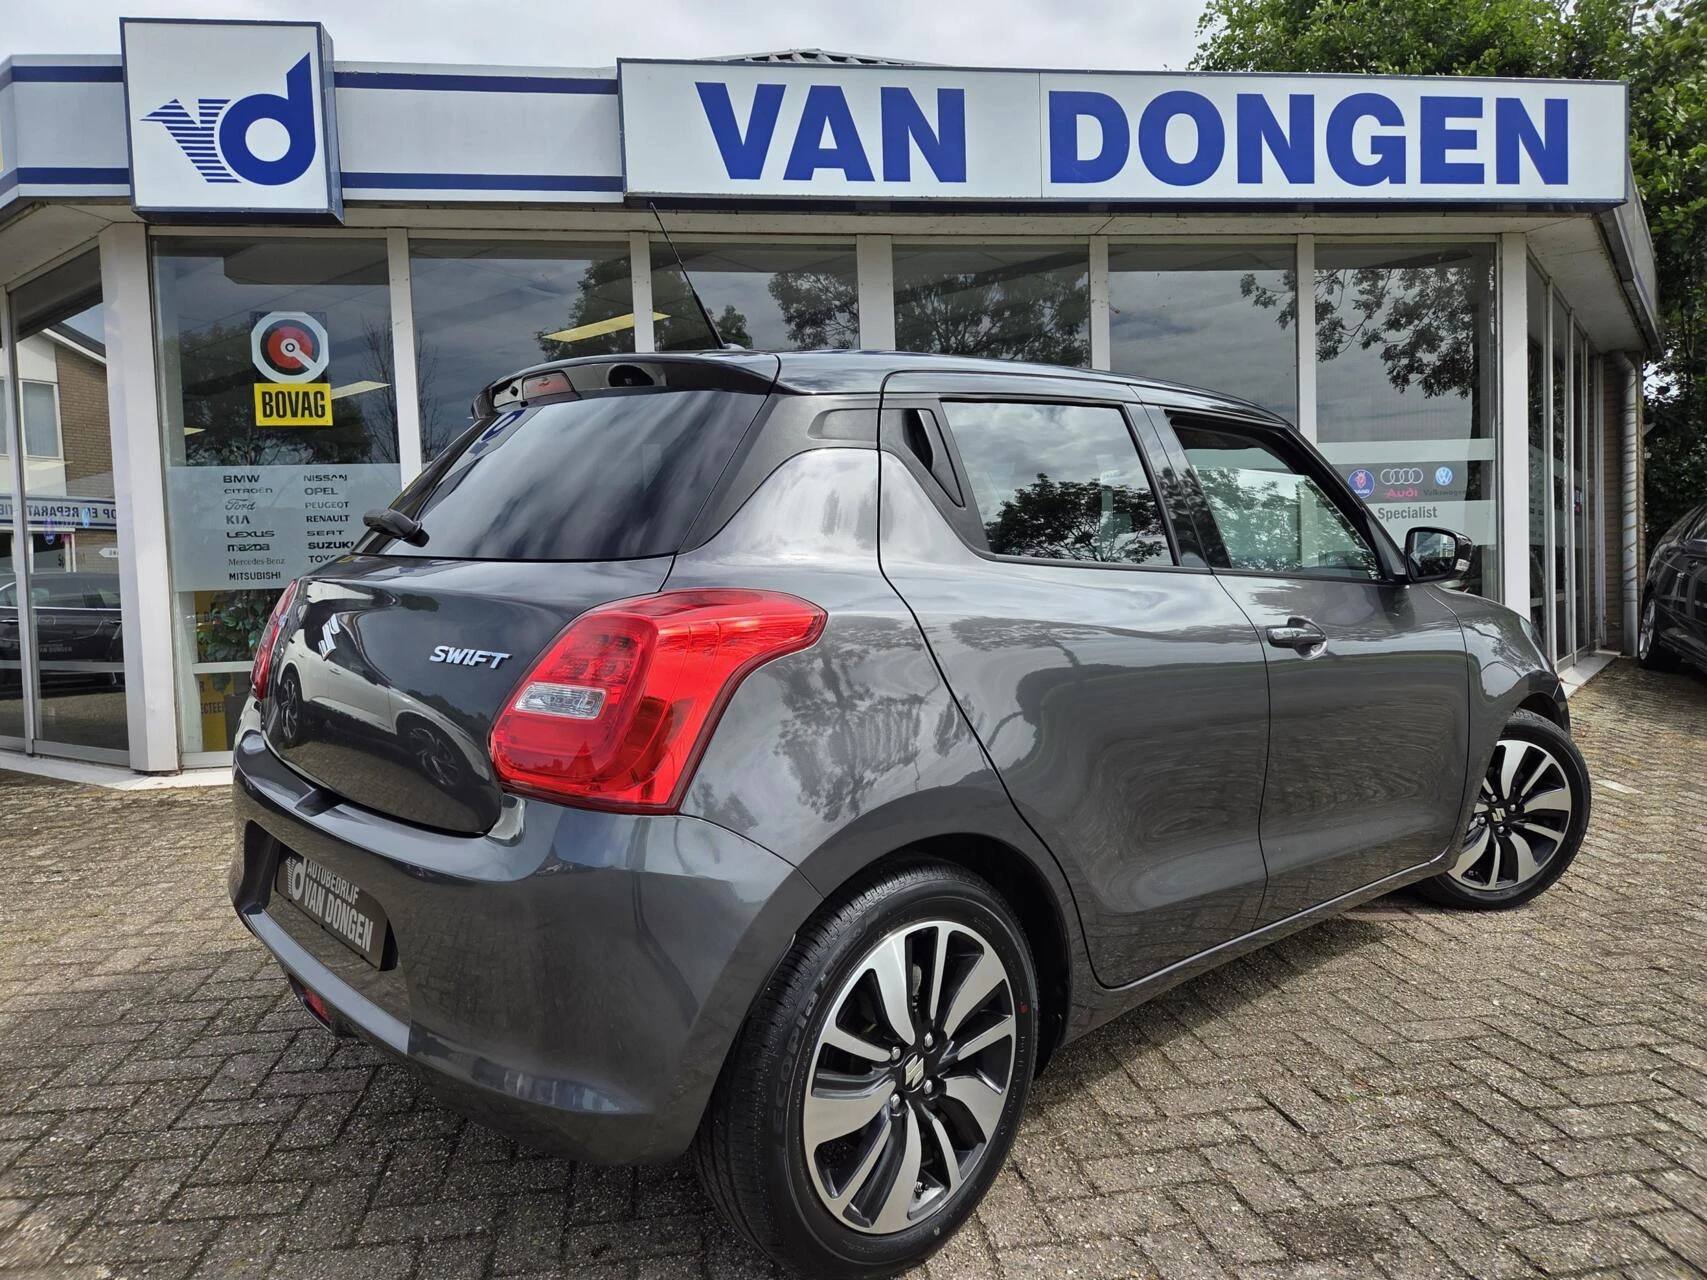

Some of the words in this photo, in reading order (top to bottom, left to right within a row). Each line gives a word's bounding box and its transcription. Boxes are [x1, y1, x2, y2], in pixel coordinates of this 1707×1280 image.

[695, 81, 967, 183] VAN
[1049, 90, 1569, 187] DONGEN
[261, 390, 326, 418] BOVAG
[223, 474, 260, 483] BMW
[303, 474, 347, 482] NISSAN
[304, 487, 338, 496] OPEL
[1386, 488, 1418, 497] Audi
[225, 498, 257, 511] Ford
[305, 501, 350, 509] PEUGEOT
[306, 514, 350, 523] RENAULT
[1377, 506, 1438, 522] Specialist
[226, 515, 250, 525] KIA
[226, 530, 275, 539] LEXUS
[307, 529, 344, 537] SEAT
[228, 558, 285, 567] Mercedes-Benz
[229, 572, 281, 581] MITSUBISHI
[429, 645, 512, 669] SWIFT
[307, 861, 360, 905] AUTOBEDRIJF
[304, 877, 325, 917] VAN
[325, 893, 373, 953] DONGEN
